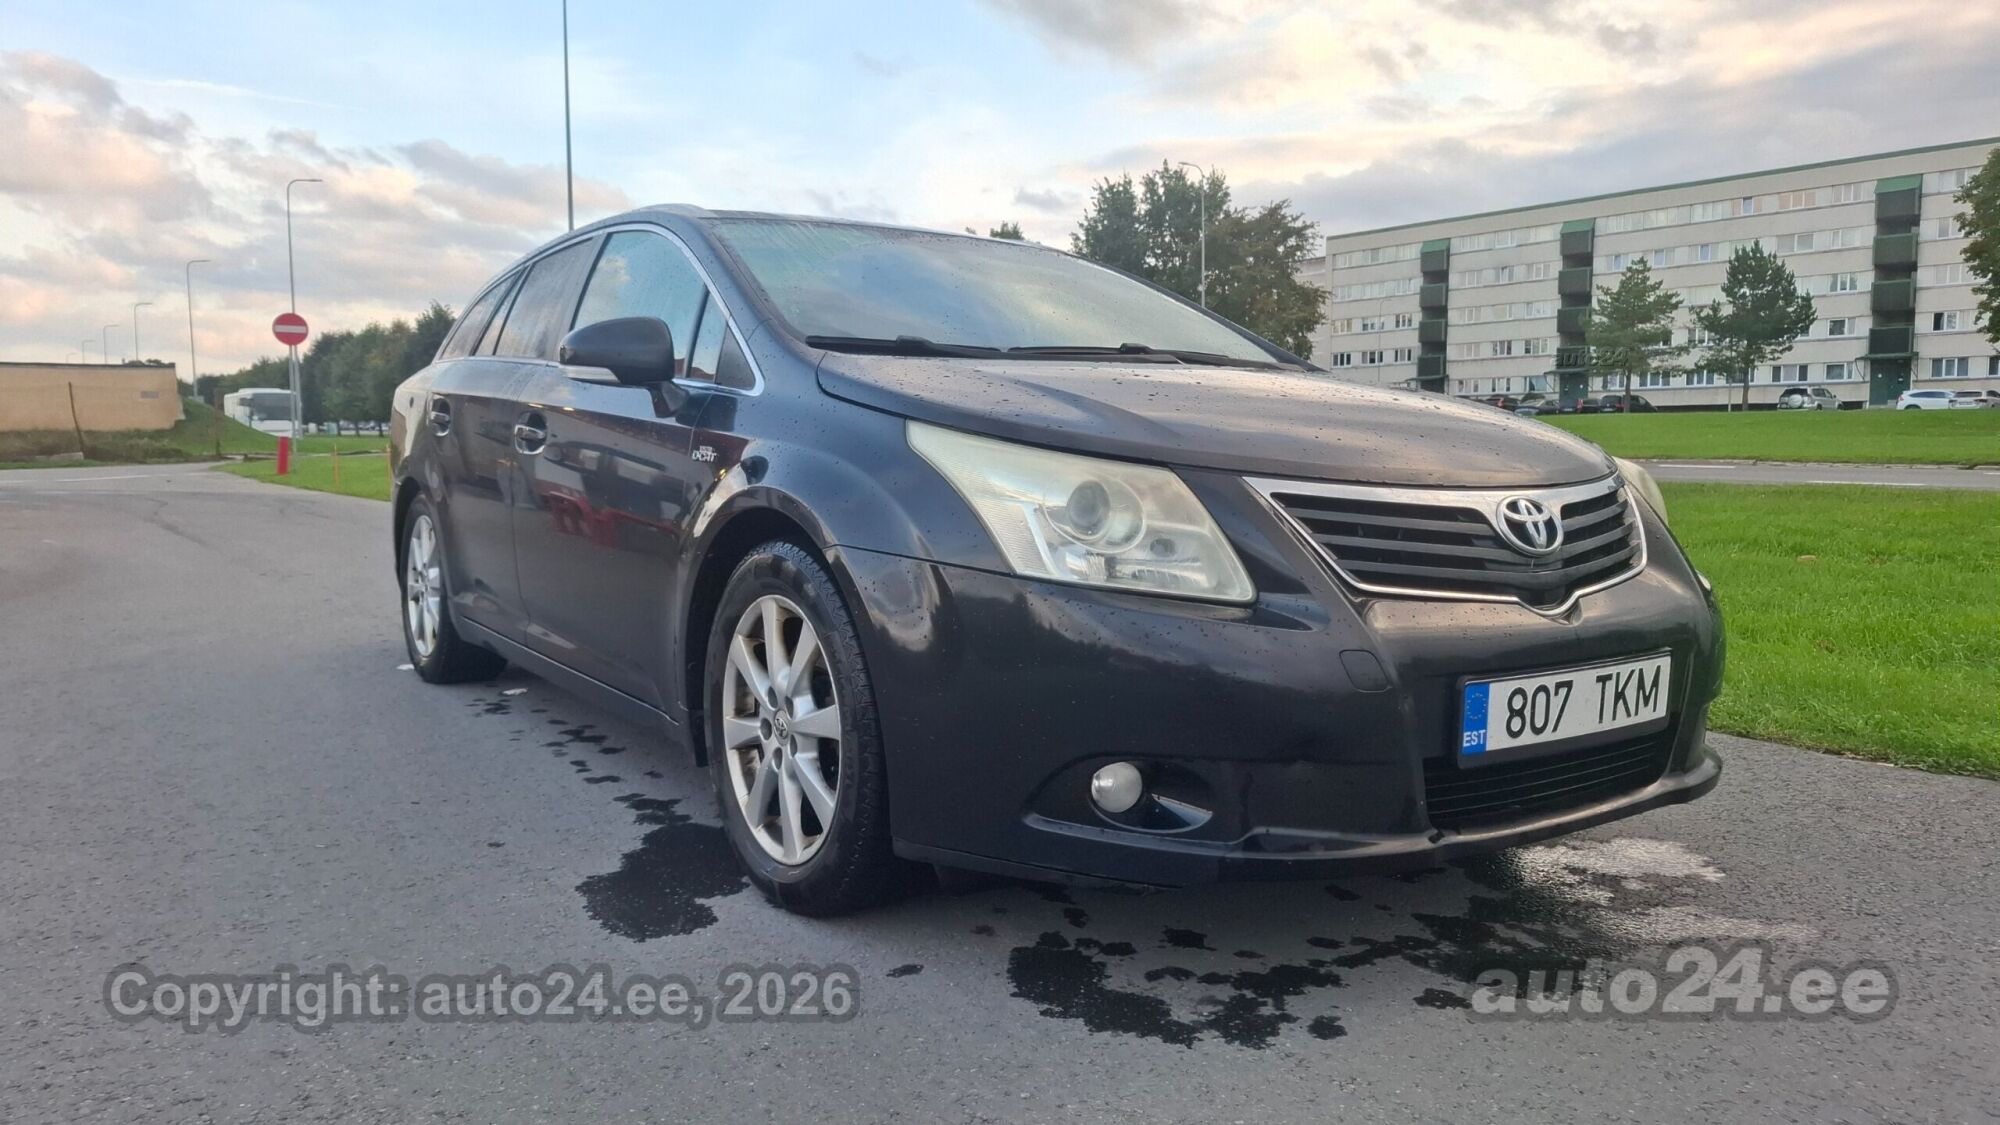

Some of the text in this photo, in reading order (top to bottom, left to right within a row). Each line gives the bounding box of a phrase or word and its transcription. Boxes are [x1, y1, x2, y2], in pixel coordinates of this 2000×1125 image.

[1505, 665, 1662, 739] 807 TKM
[1462, 729, 1487, 748] EST
